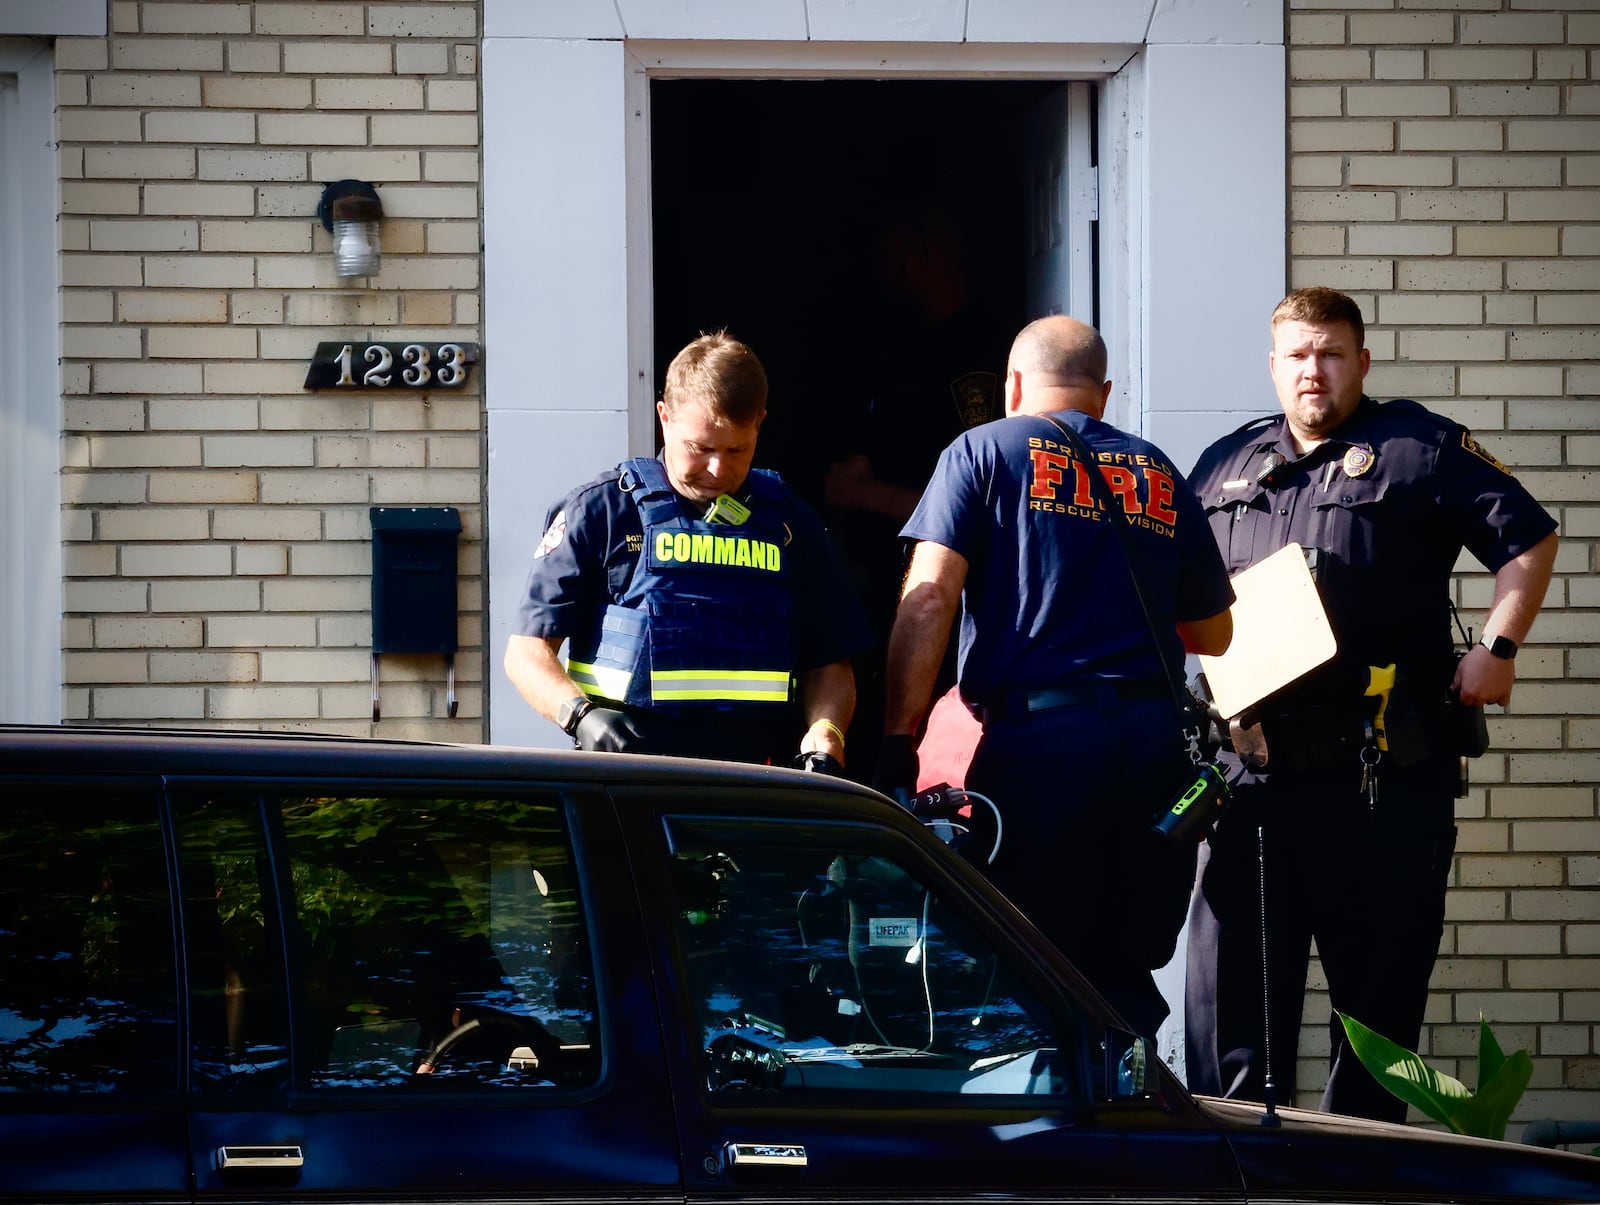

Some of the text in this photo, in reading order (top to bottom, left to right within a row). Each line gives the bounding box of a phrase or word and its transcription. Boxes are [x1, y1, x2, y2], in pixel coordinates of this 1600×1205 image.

[333, 344, 466, 387] 1233
[1028, 436, 1173, 477] SPRIGFIELD
[1029, 449, 1177, 526] FIRE
[1028, 500, 1176, 539] RESCUE VISION
[655, 532, 781, 572] COMMAND
[875, 925, 910, 936] LIFEPAK
